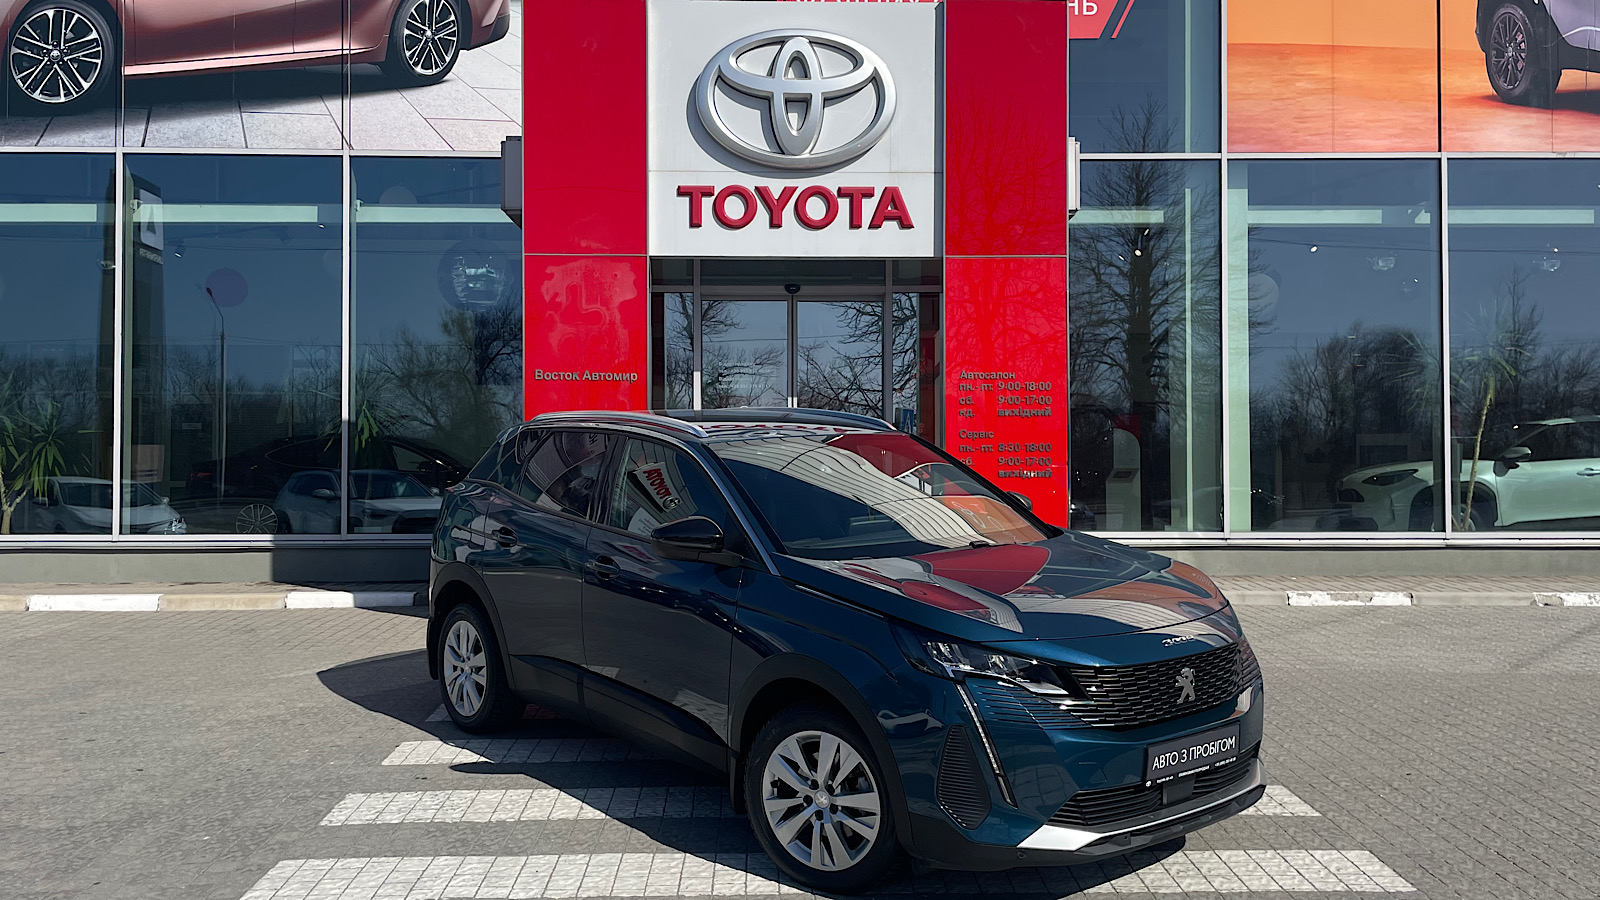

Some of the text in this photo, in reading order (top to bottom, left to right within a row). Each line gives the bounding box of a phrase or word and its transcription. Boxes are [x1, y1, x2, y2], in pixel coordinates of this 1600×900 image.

[677, 184, 915, 230] TOYOTA
[534, 369, 638, 384] Восток Автомир
[959, 370, 1016, 380] Автосалон
[998, 381, 1052, 391] 9:00-18:00
[959, 395, 1052, 405] сб. 9:00-17:00
[997, 407, 1052, 418] вихідний
[959, 429, 995, 440] Сервіс
[998, 456, 1052, 466] 9:00-17:00
[998, 467, 1053, 479] вихідний
[1152, 751, 1179, 771] АВТО
[1189, 735, 1236, 761] ПРОБІГОМ
